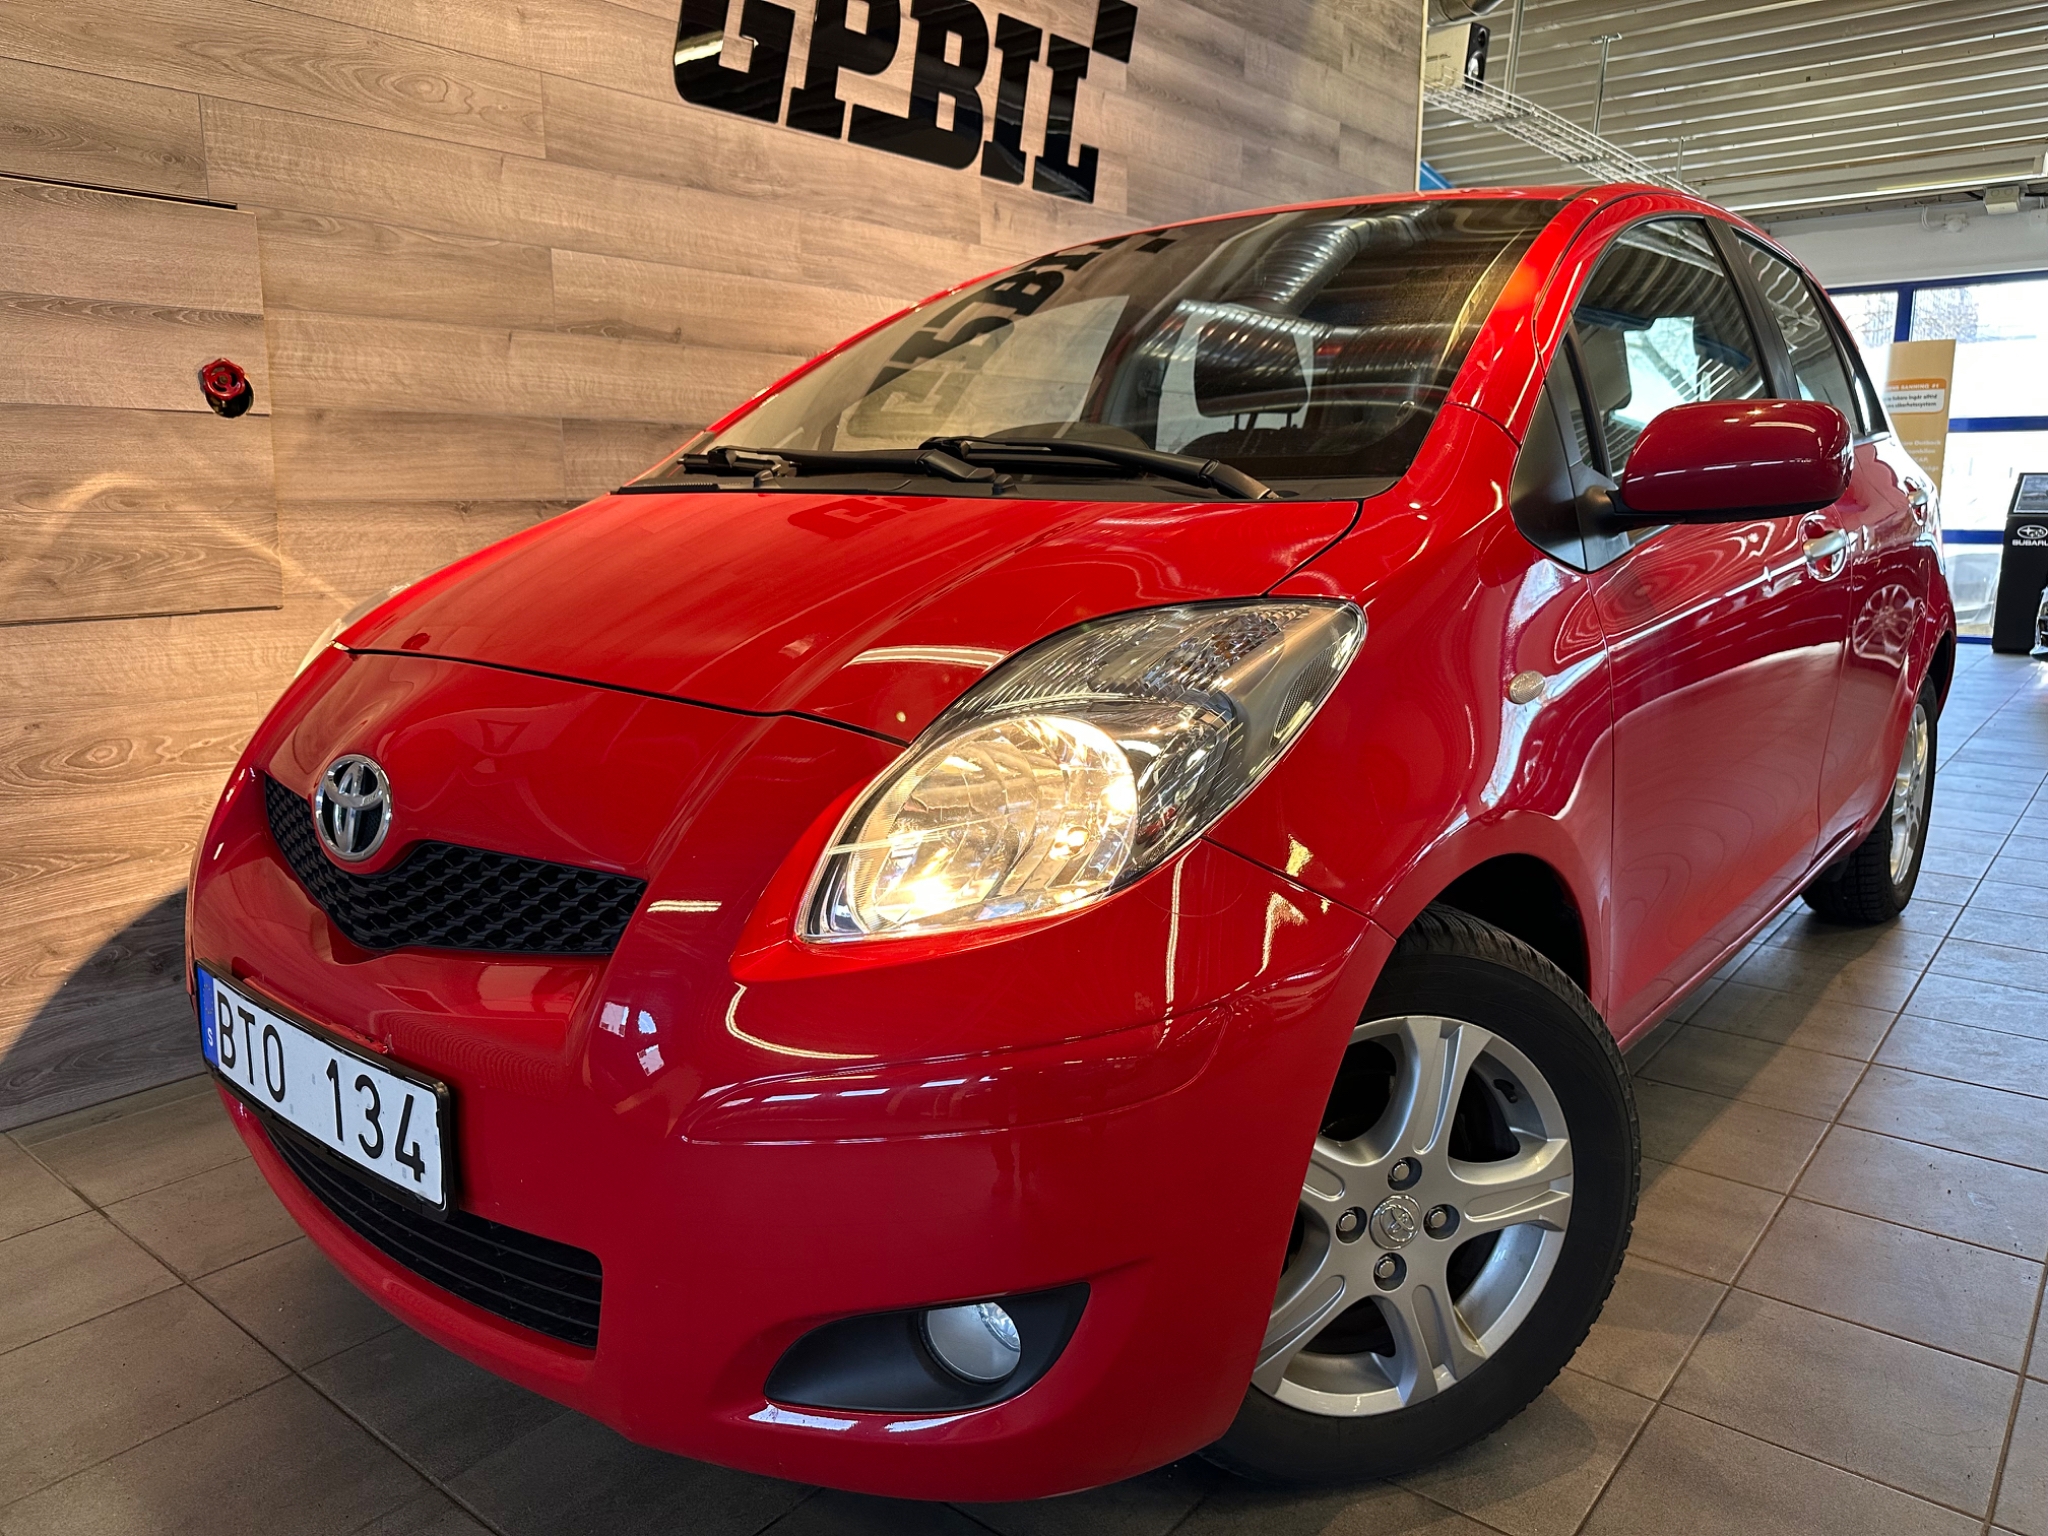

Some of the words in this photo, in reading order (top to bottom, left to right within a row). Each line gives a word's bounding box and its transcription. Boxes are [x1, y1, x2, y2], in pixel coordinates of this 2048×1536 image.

[673, 0, 1100, 204] GPBIL
[207, 1027, 214, 1047] S
[217, 990, 286, 1103] BTO
[326, 1058, 426, 1183] 134
